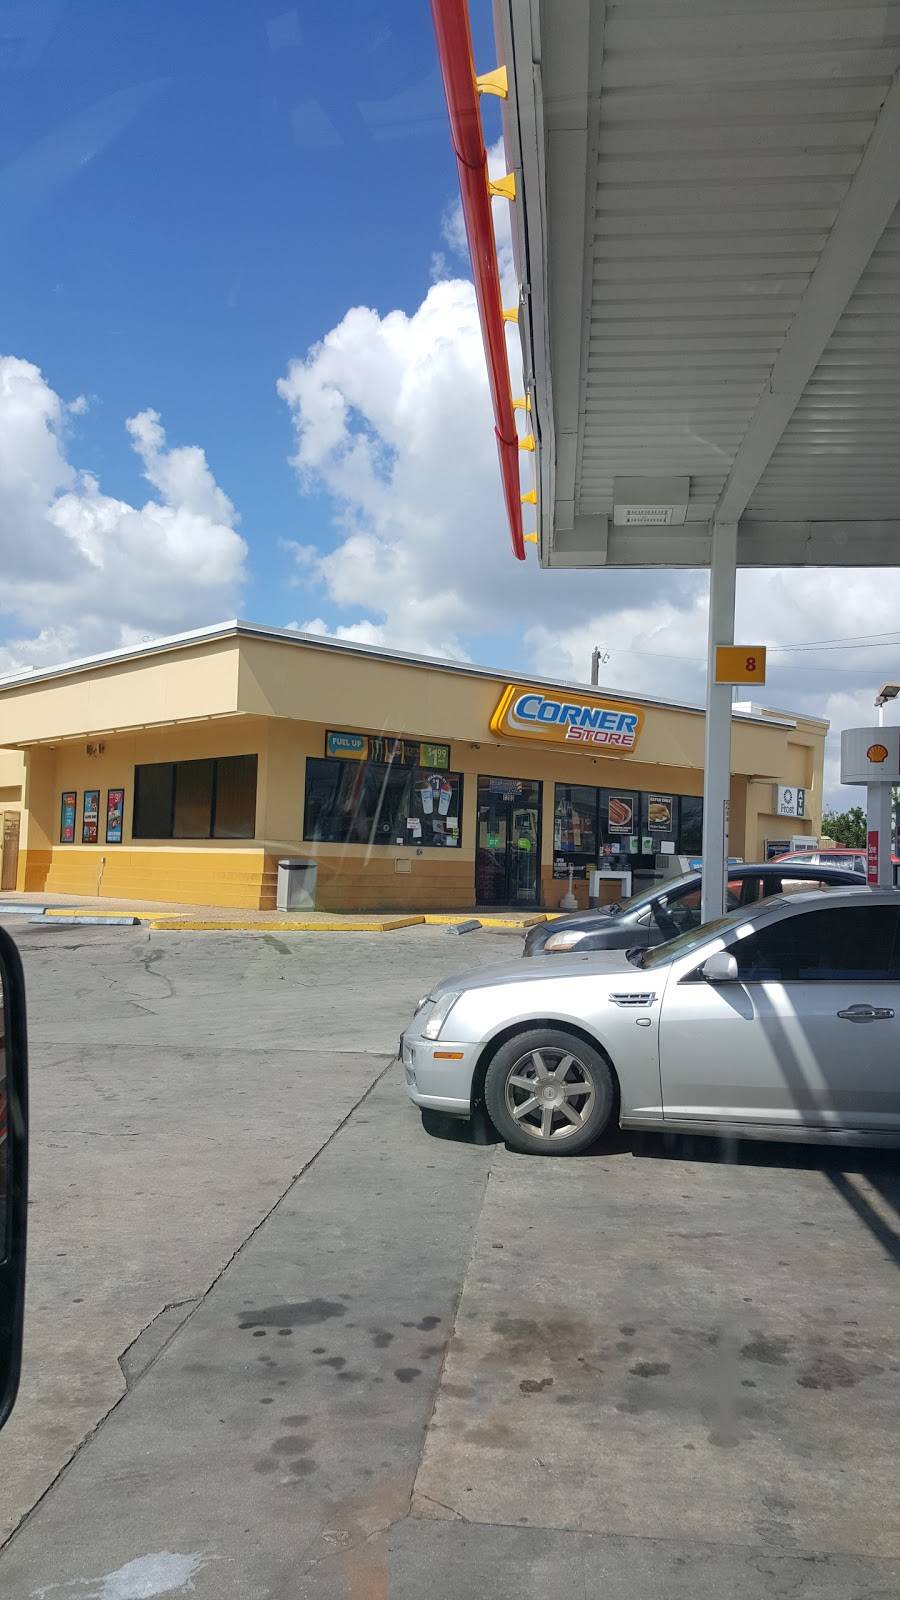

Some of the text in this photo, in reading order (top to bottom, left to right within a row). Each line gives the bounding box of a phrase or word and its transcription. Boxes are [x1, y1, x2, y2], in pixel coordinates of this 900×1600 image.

[745, 656, 756, 672] 8
[513, 693, 638, 734] CORNER
[332, 737, 362, 747] FUEL UP
[566, 725, 635, 746] STORE
[780, 803, 795, 815] Frost
